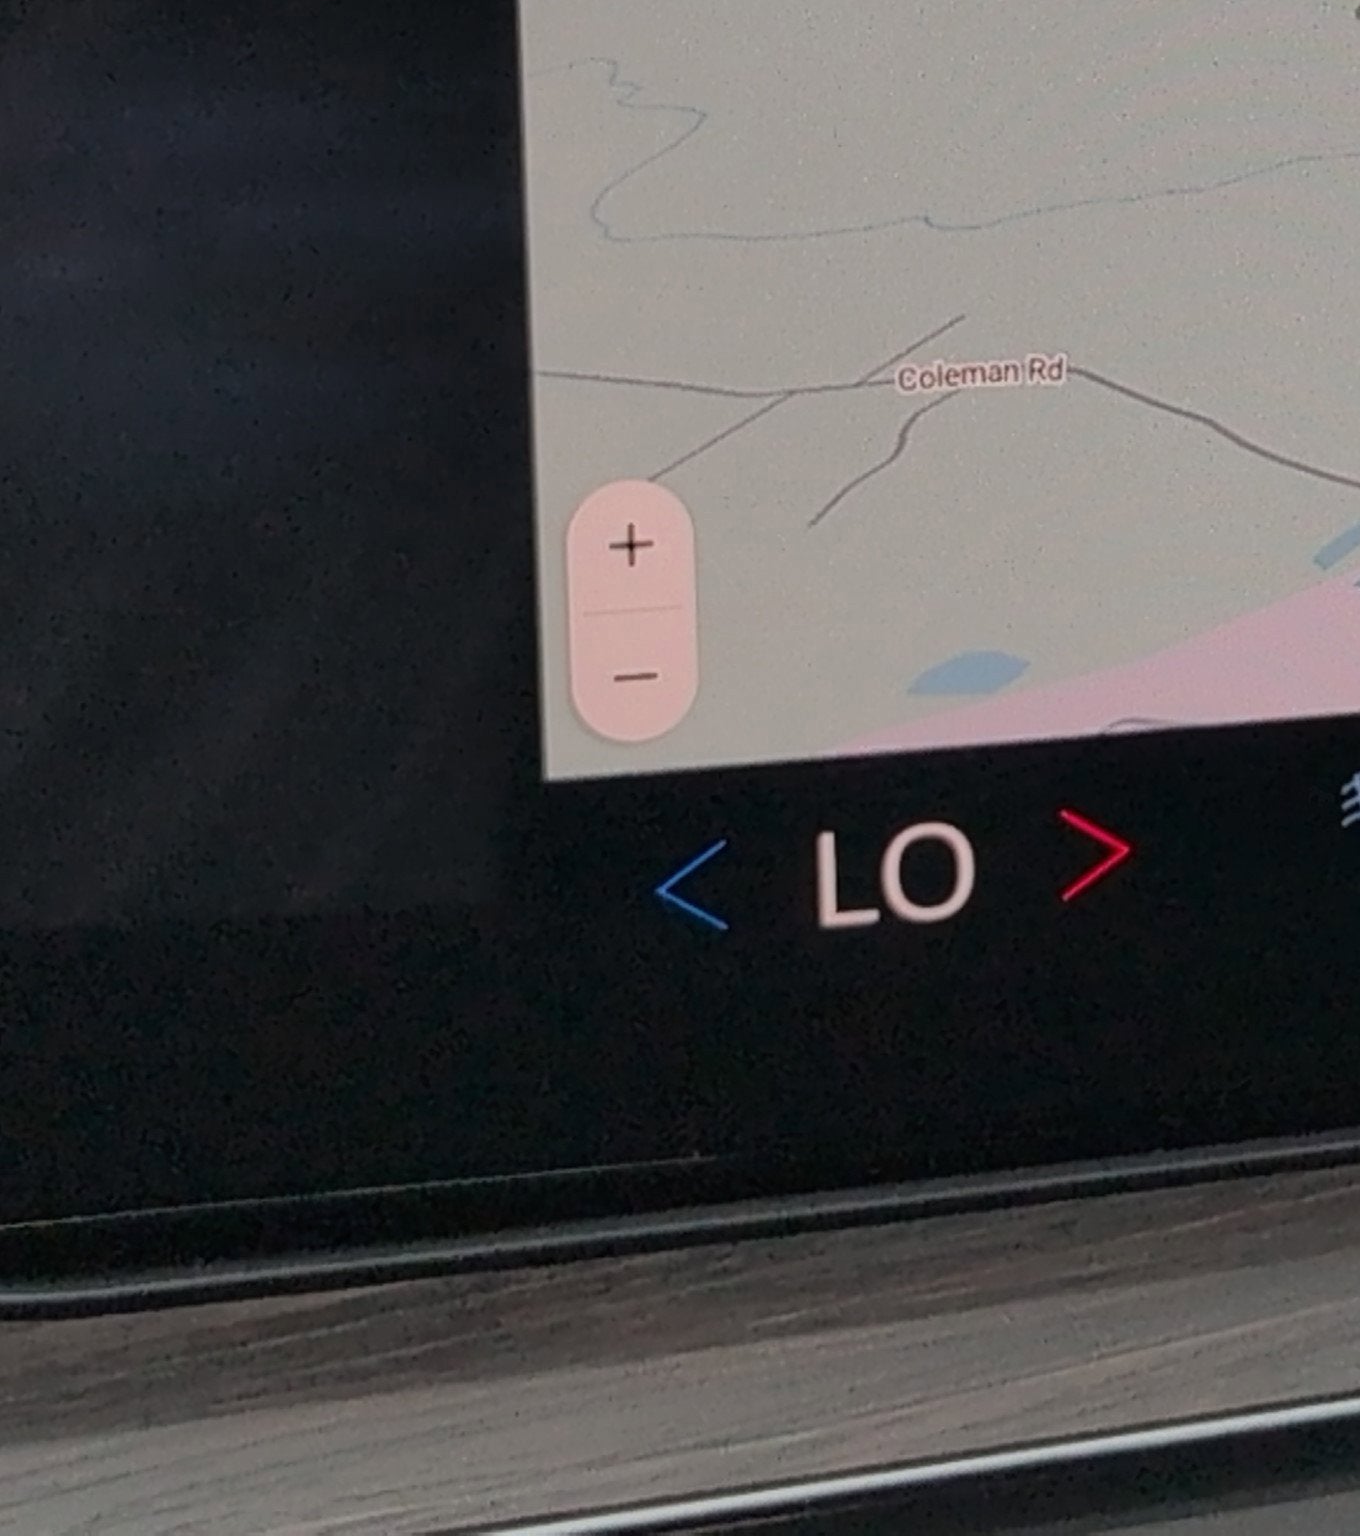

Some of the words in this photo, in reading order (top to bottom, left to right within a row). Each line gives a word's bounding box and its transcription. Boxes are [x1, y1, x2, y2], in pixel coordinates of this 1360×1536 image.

[897, 362, 1021, 393] Coleman
[1029, 356, 1066, 383] Rd
[814, 819, 978, 930] LO
